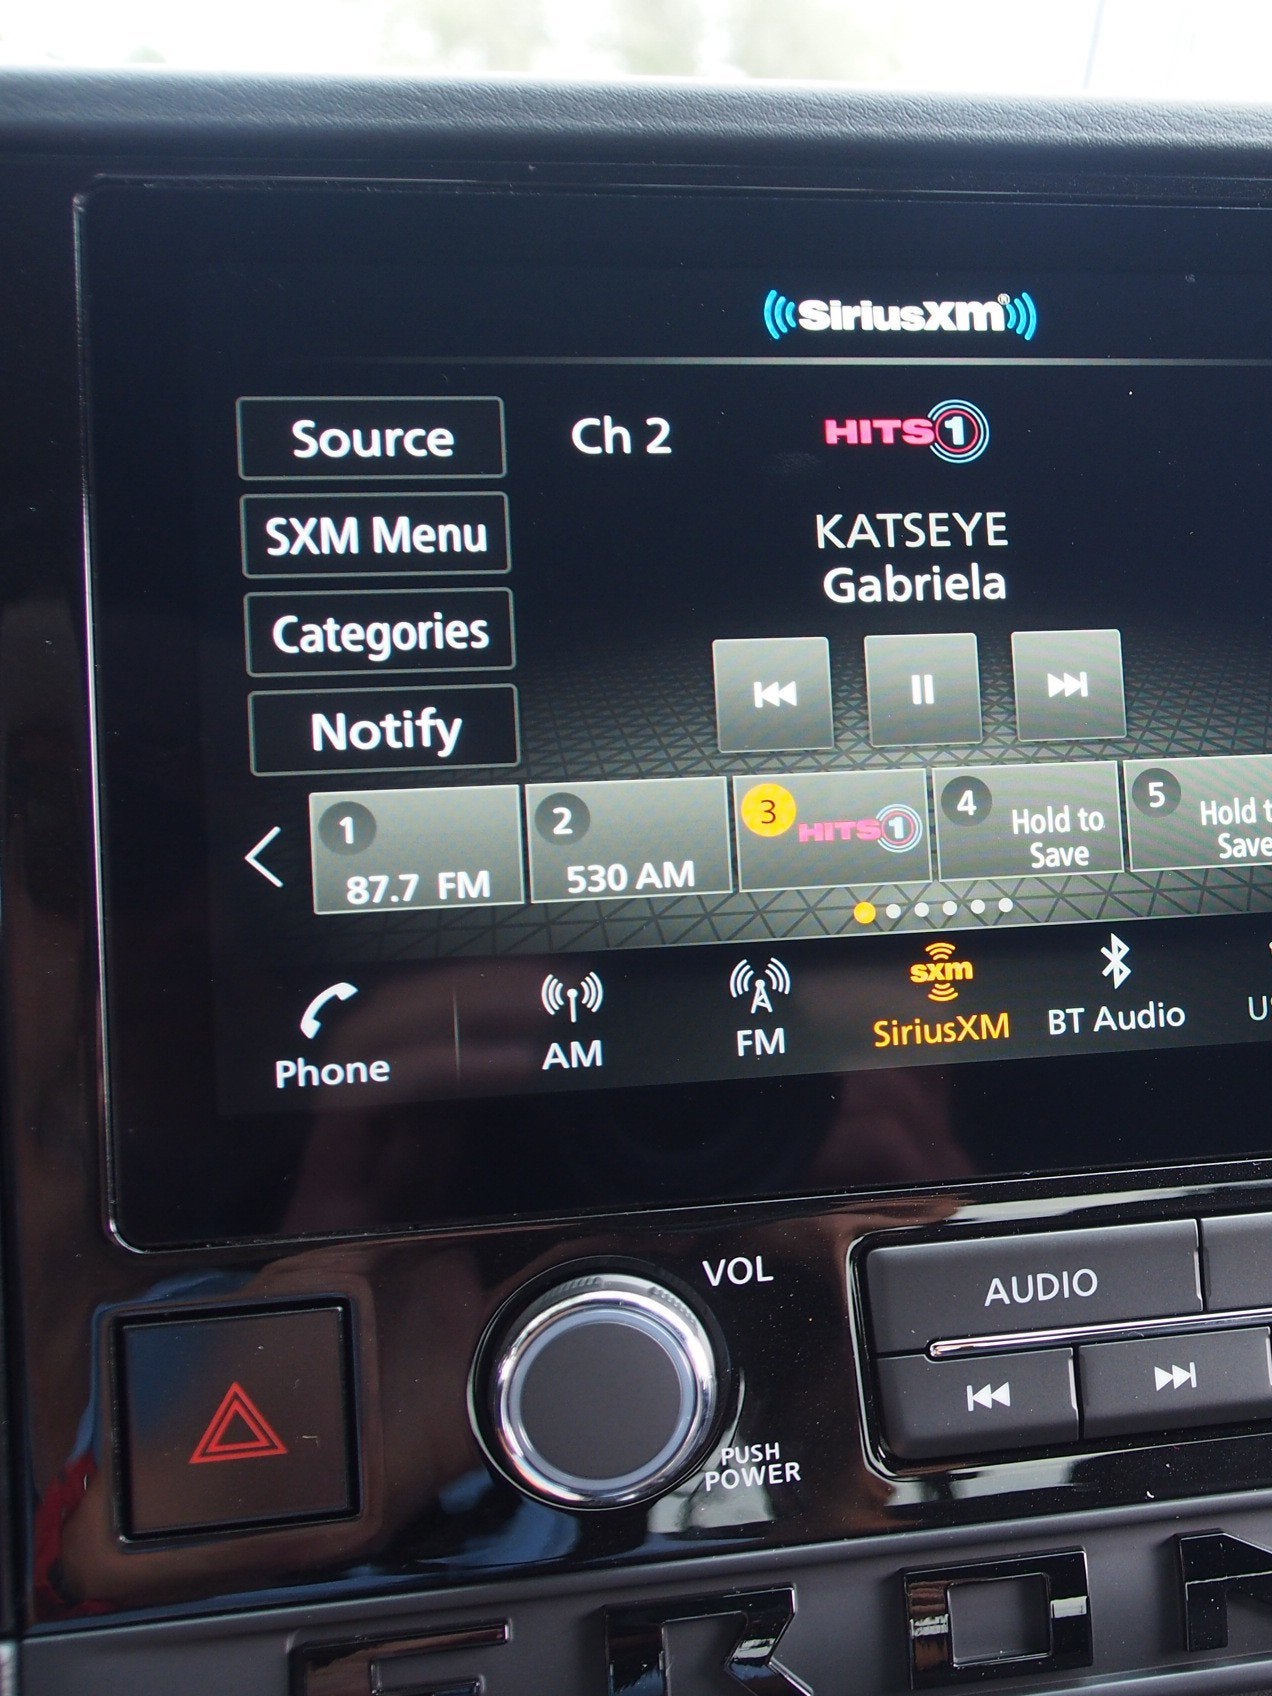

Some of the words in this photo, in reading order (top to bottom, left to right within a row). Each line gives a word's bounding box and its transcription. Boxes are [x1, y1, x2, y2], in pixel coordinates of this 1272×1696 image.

[292, 420, 455, 457] Source
[571, 415, 632, 454] Ch
[646, 417, 672, 454] 2
[825, 419, 935, 444] HITS
[944, 416, 965, 446] 1
[265, 516, 359, 556] SXM
[373, 516, 488, 553] Menu
[815, 512, 1009, 549] KATSEYE
[823, 562, 1008, 604] Gabriela
[272, 611, 490, 662] Categories
[310, 706, 463, 757] Notify
[956, 790, 977, 816] 4
[1148, 782, 1167, 808] 5
[552, 807, 574, 835] 2
[760, 799, 777, 825] 3
[1011, 806, 1071, 835] Hold
[1077, 807, 1104, 831] to
[1200, 798, 1257, 826] Hold
[338, 816, 356, 844] 1
[798, 818, 882, 843] HITS
[888, 816, 905, 839] 1
[1030, 842, 1090, 869] Save
[346, 873, 420, 905] 87.7
[437, 871, 491, 899] FM
[566, 864, 627, 893] 530
[635, 860, 696, 890] AM
[873, 1012, 1011, 1049] SiriusXM
[1048, 1007, 1085, 1036] BT
[1093, 1000, 1186, 1032] Audio
[541, 1039, 604, 1070] AM
[736, 1027, 786, 1057] FM
[275, 1057, 391, 1089] Phone
[702, 1256, 774, 1287] VOL
[984, 1268, 1098, 1307] AUDIO
[720, 1442, 781, 1467] PUSH
[704, 1461, 802, 1492] POWER
